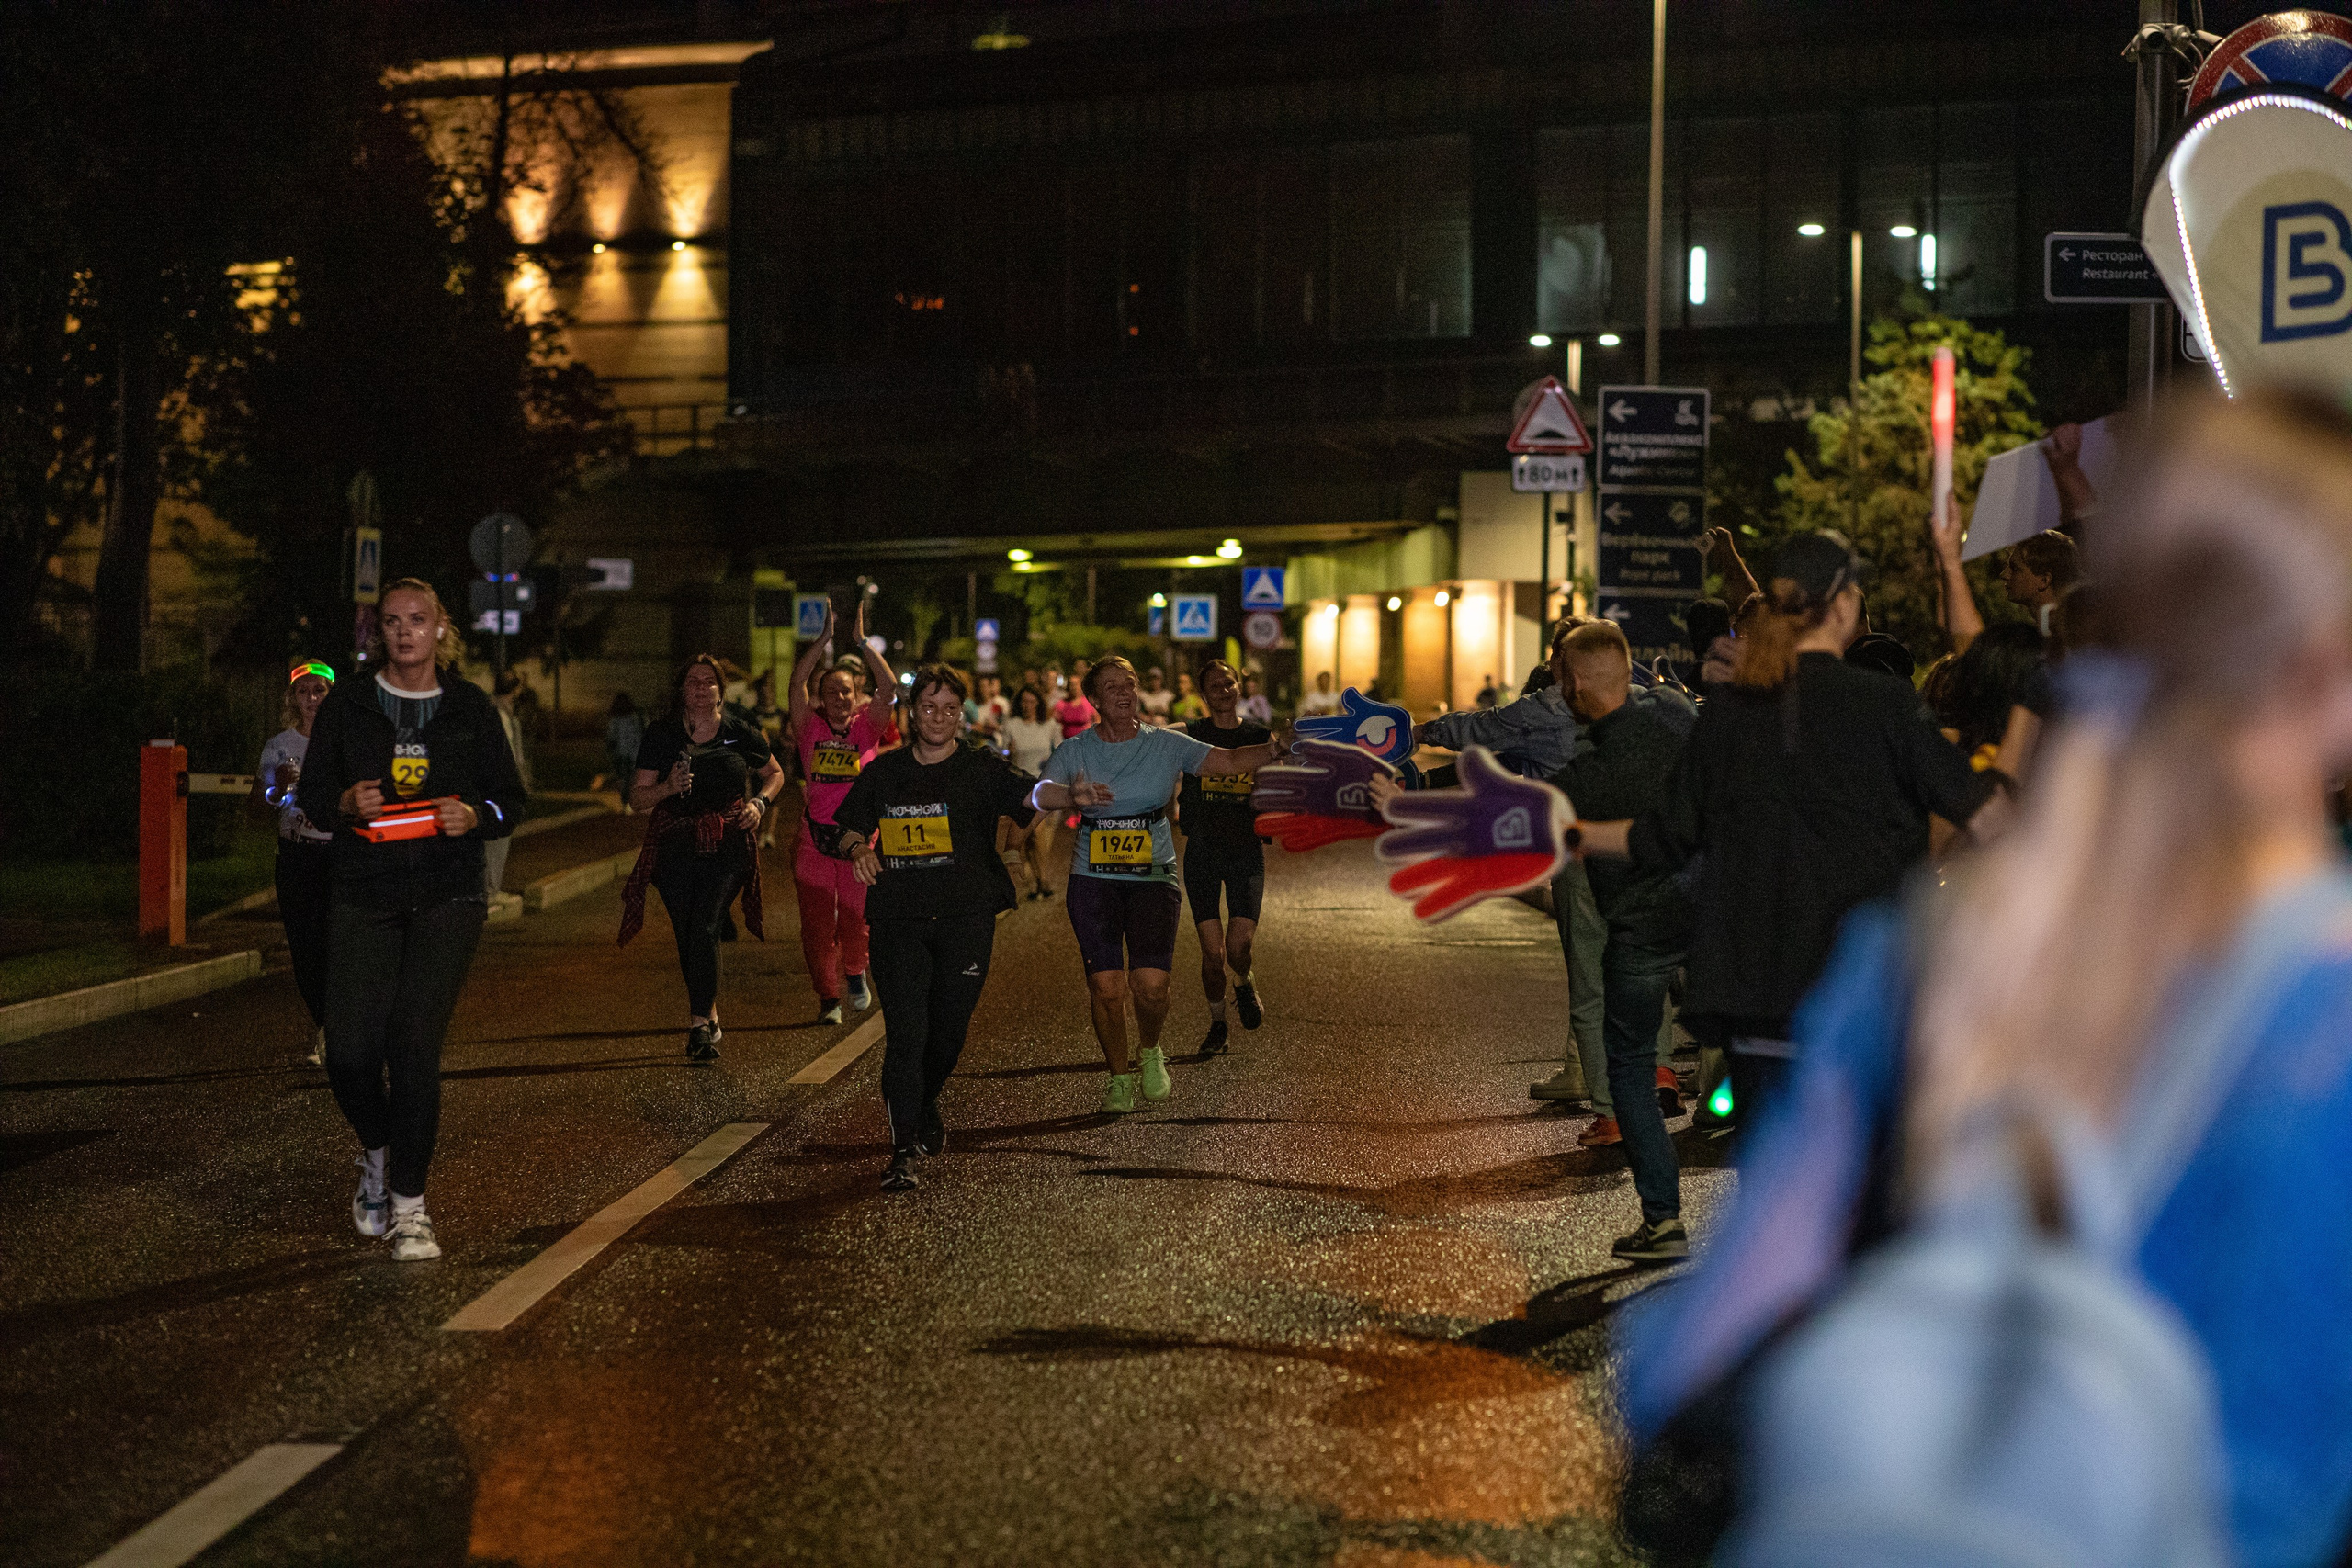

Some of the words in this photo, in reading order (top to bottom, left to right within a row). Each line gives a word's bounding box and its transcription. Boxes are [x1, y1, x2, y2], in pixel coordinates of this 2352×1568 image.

[2082, 250, 2143, 264] Ресторан
[2082, 268, 2149, 279] Restaurant
[818, 752, 854, 767] 7474
[902, 823, 925, 844] 11
[897, 843, 935, 852] АНАСТАСИЯ
[1100, 835, 1145, 853] 1947
